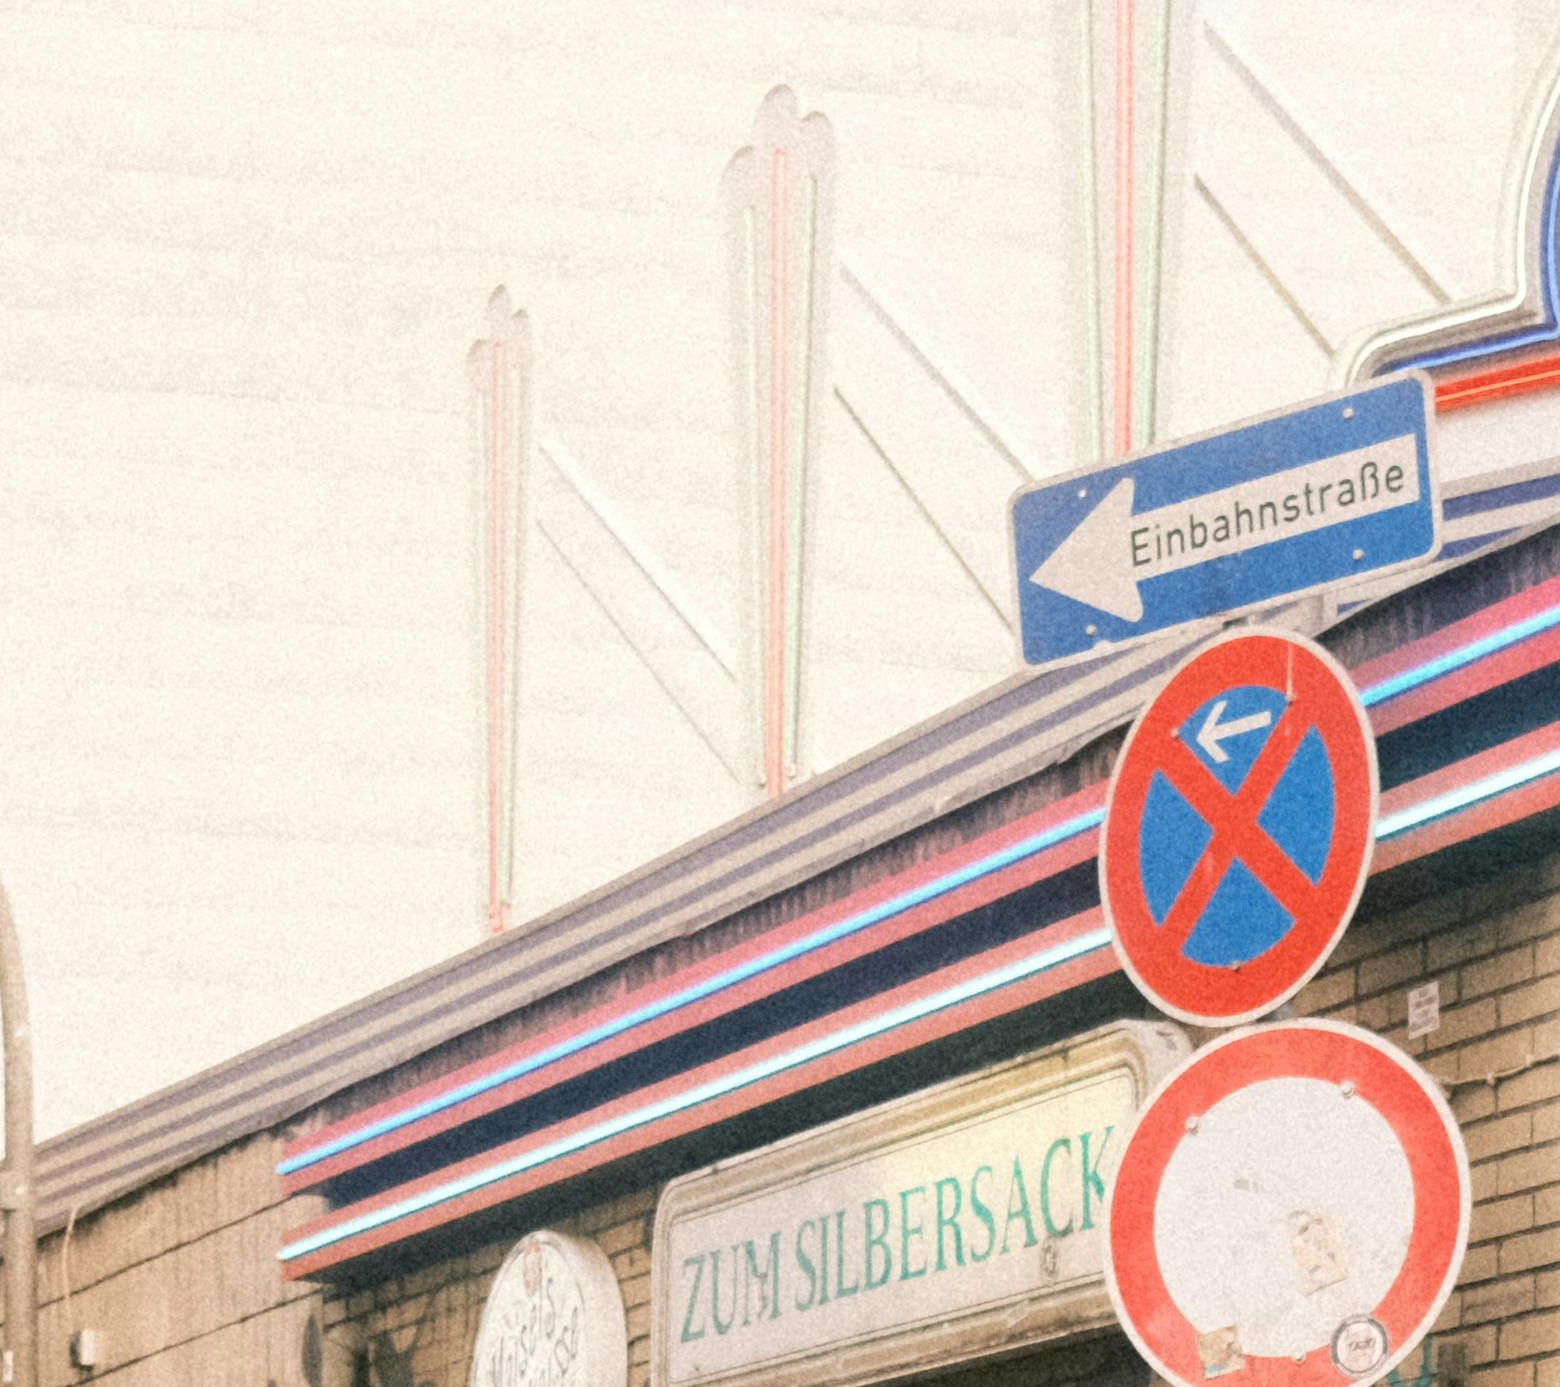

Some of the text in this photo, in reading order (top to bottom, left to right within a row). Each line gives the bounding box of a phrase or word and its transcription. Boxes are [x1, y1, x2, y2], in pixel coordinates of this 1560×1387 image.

[1129, 460, 1405, 568] Einbahnstraße
[680, 1124, 1116, 1344] ZUM SILBERSACK
